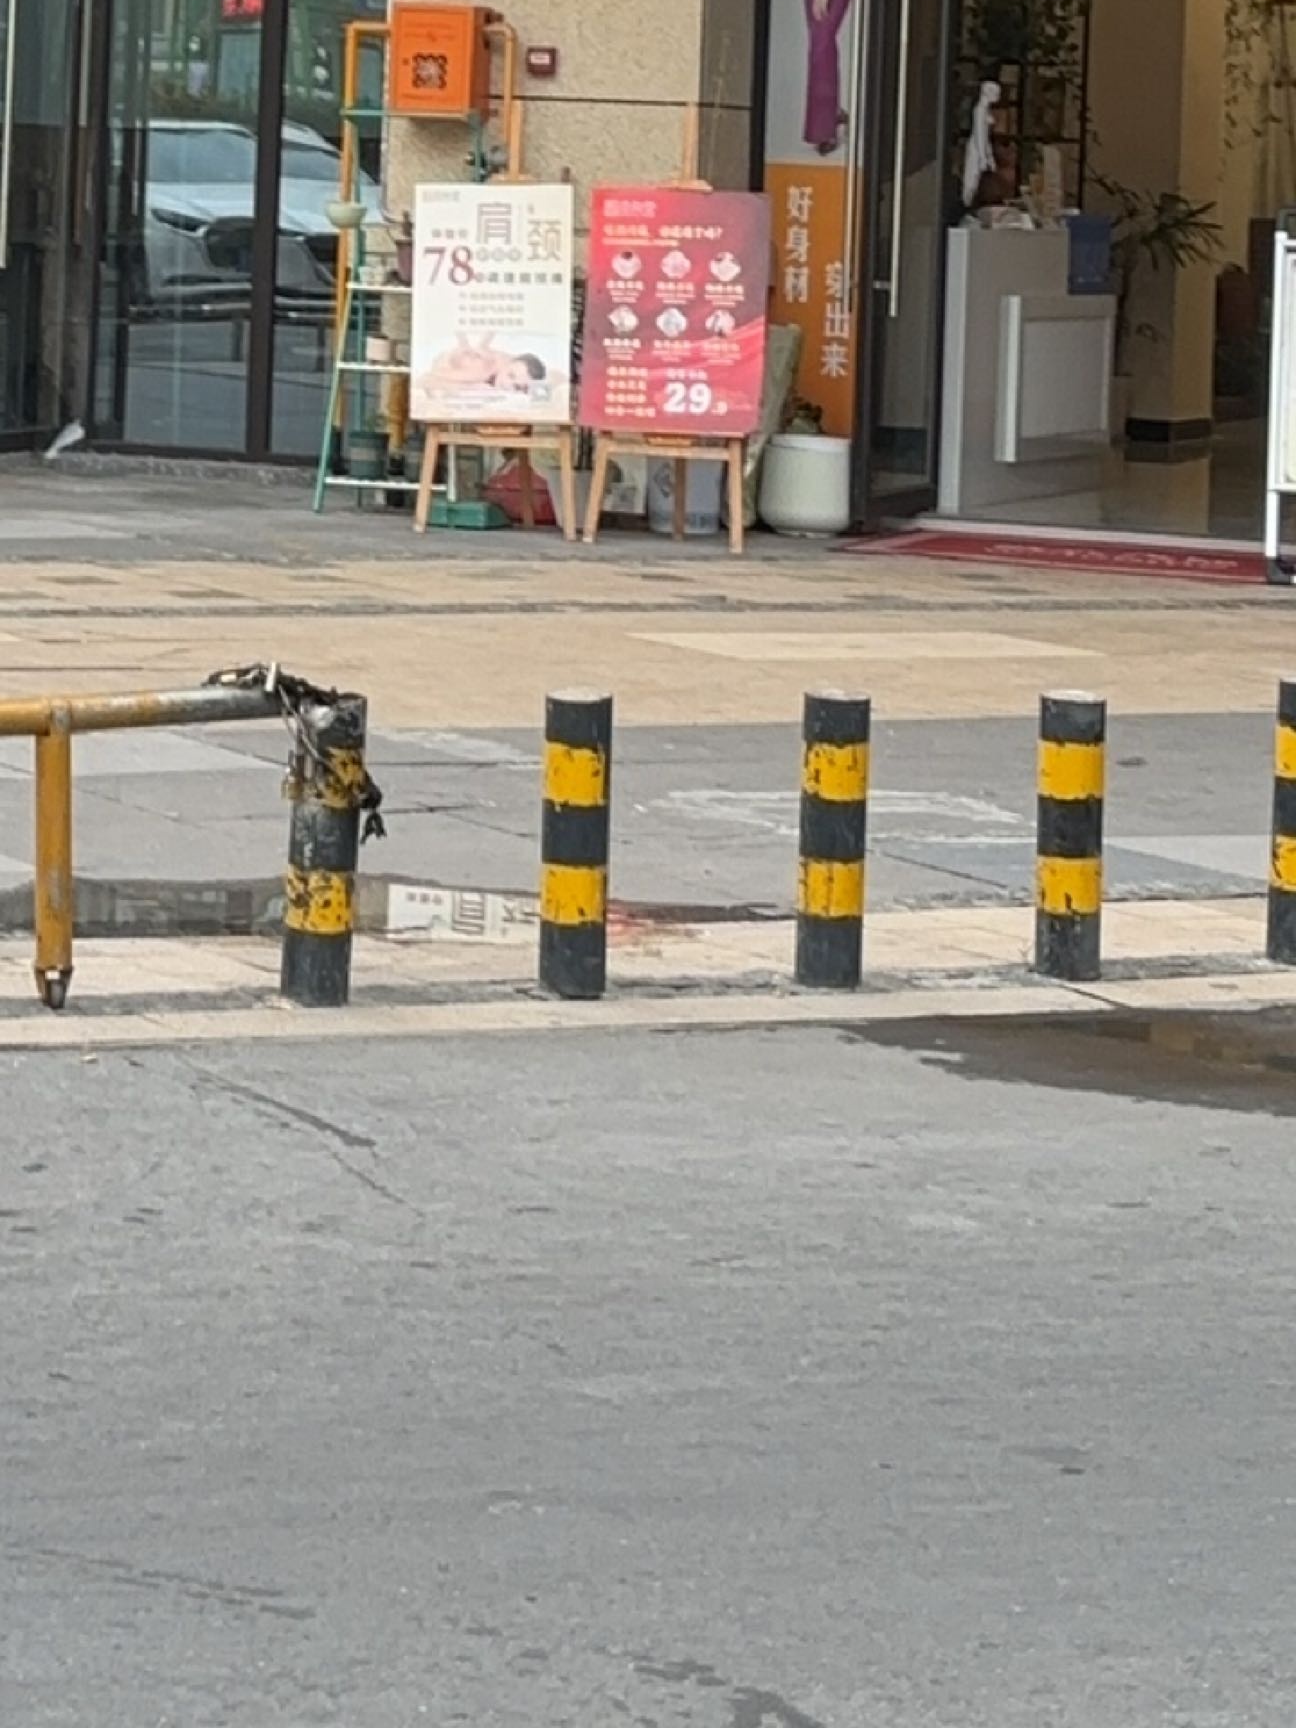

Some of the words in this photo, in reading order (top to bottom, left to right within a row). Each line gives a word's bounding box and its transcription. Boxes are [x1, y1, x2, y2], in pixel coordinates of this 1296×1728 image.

[476, 201, 512, 244] 肩
[527, 219, 561, 261] 颈
[423, 245, 475, 286] 78
